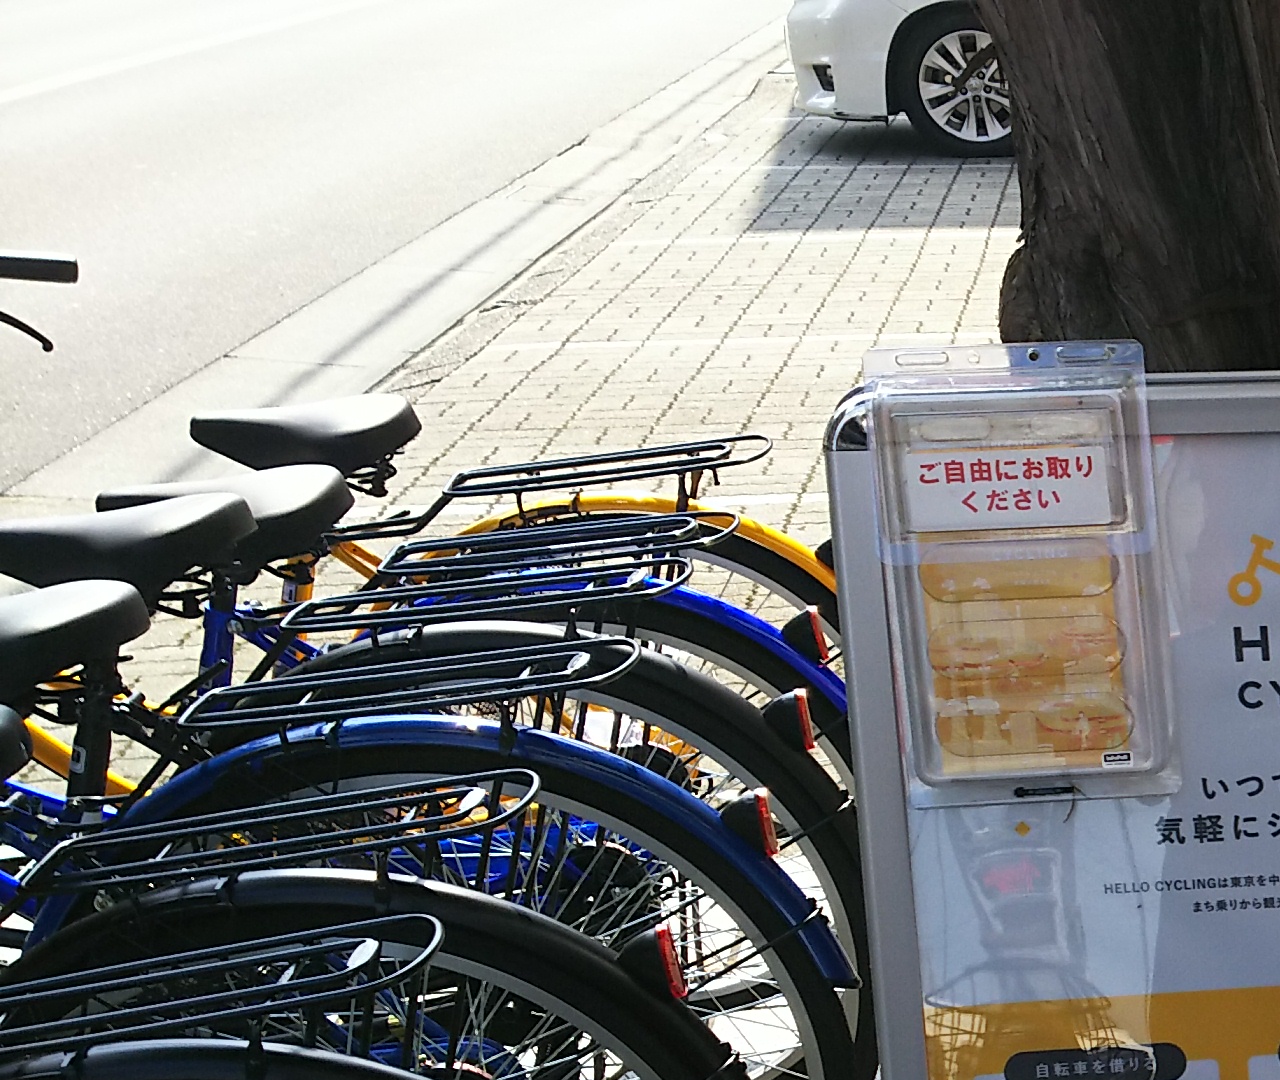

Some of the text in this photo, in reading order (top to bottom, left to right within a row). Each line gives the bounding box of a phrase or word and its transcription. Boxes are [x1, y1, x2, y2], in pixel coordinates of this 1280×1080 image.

[918, 456, 1094, 485] ご自由にお取り
[961, 488, 1061, 513] ください
[1103, 881, 1150, 895] HELLO
[1035, 1056, 1157, 1079] 自転車を借りる
